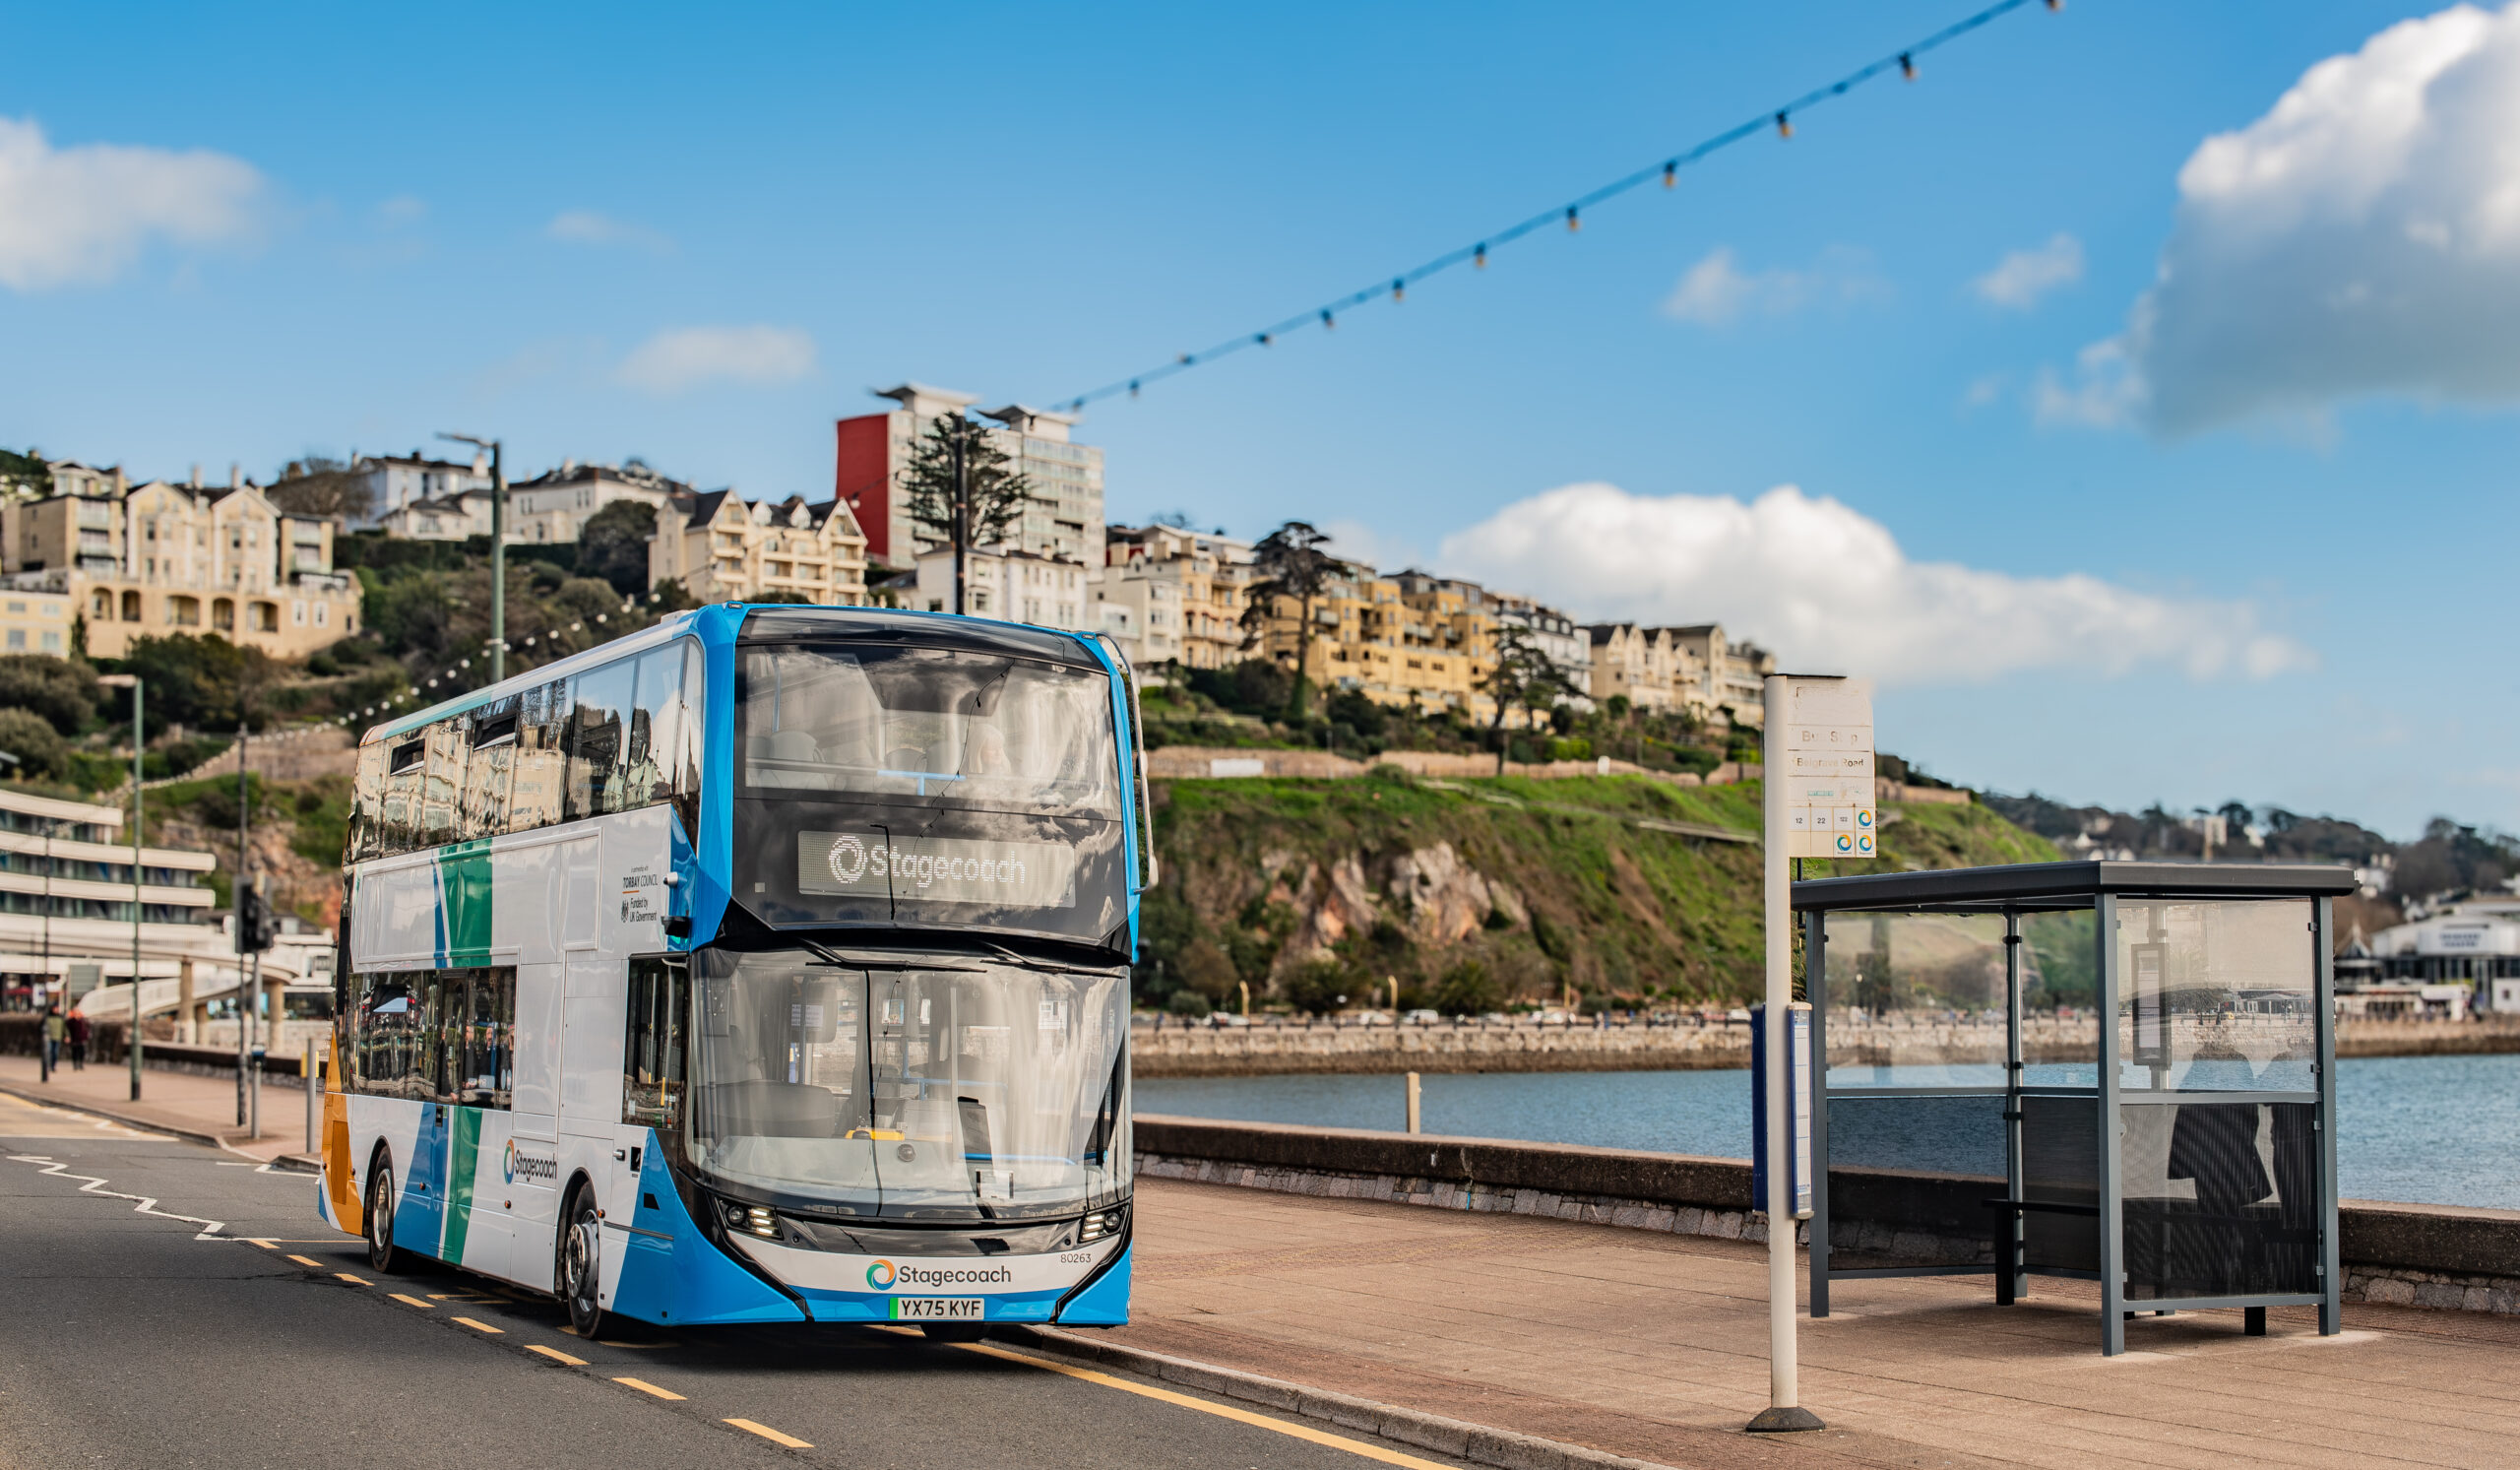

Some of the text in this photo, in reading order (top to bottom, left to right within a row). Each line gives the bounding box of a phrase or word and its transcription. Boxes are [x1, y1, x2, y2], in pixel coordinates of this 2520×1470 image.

[870, 844, 1027, 888] Stagecoach
[623, 874, 659, 889] TORBAY COUNCIL
[630, 897, 649, 910] Funded by
[630, 910, 658, 923] UK Government
[515, 1149, 558, 1182] Stagecoach
[1060, 1253, 1092, 1263] 80263
[899, 1265, 1012, 1287] Stagecoach
[901, 1300, 981, 1316] YX75 KYF
